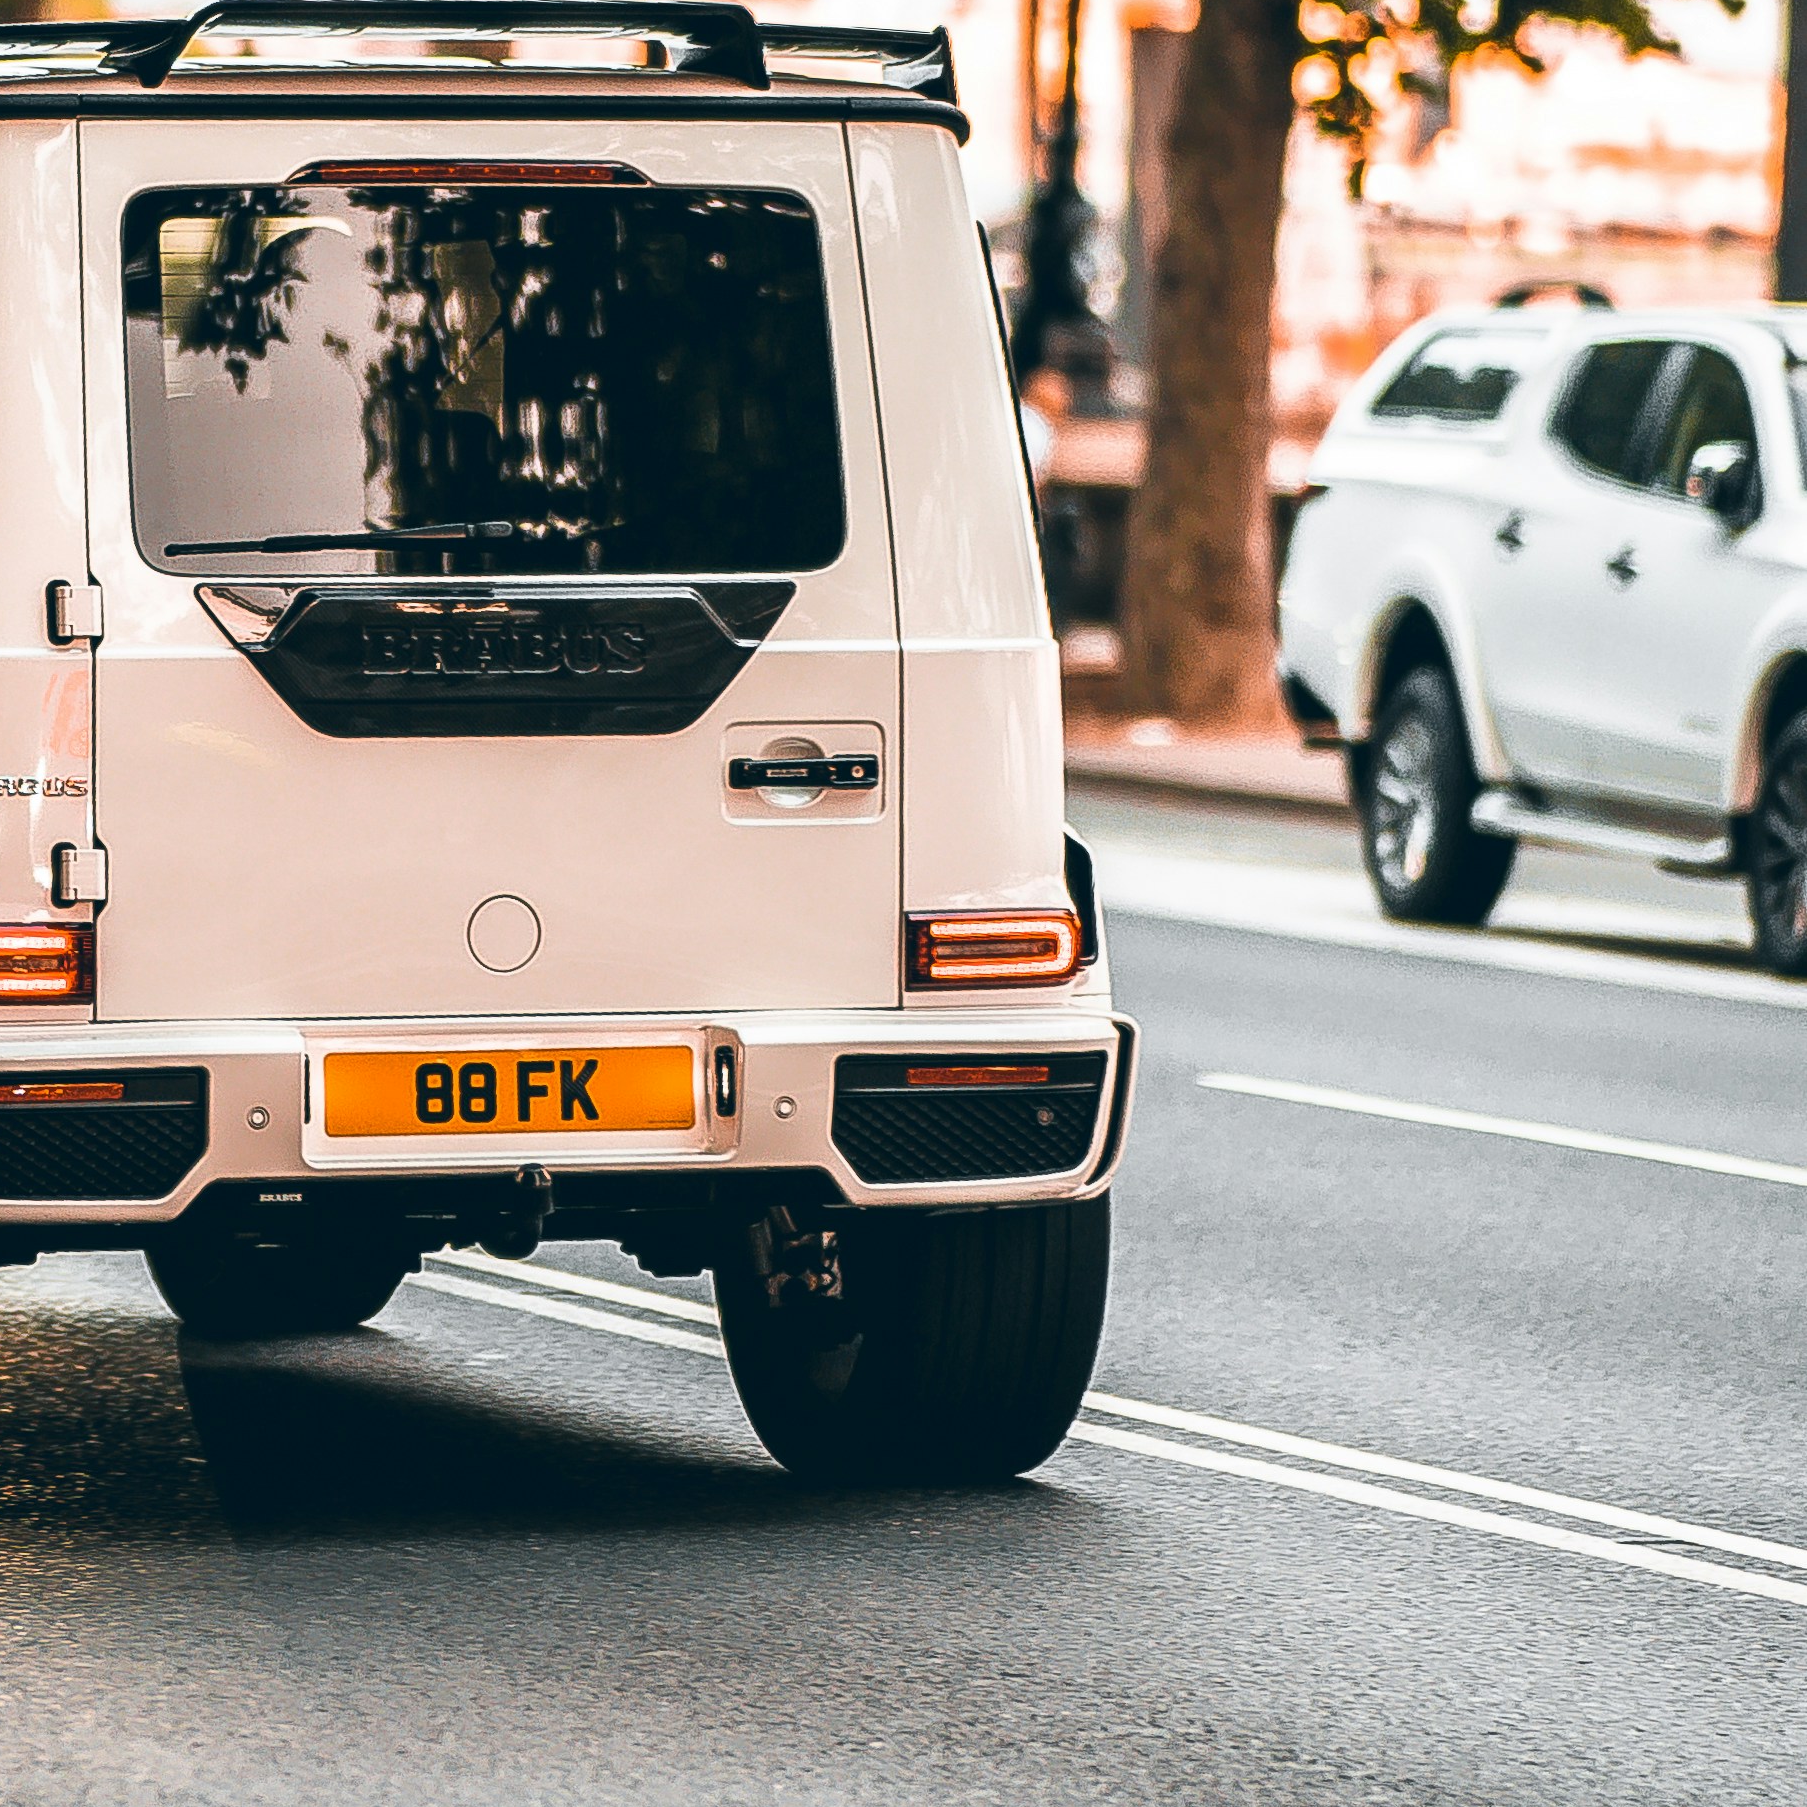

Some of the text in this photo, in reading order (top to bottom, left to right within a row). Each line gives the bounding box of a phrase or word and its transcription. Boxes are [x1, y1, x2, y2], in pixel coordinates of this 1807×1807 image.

[363, 623, 646, 675] BRABUS
[415, 1058, 600, 1124] 88 FK
